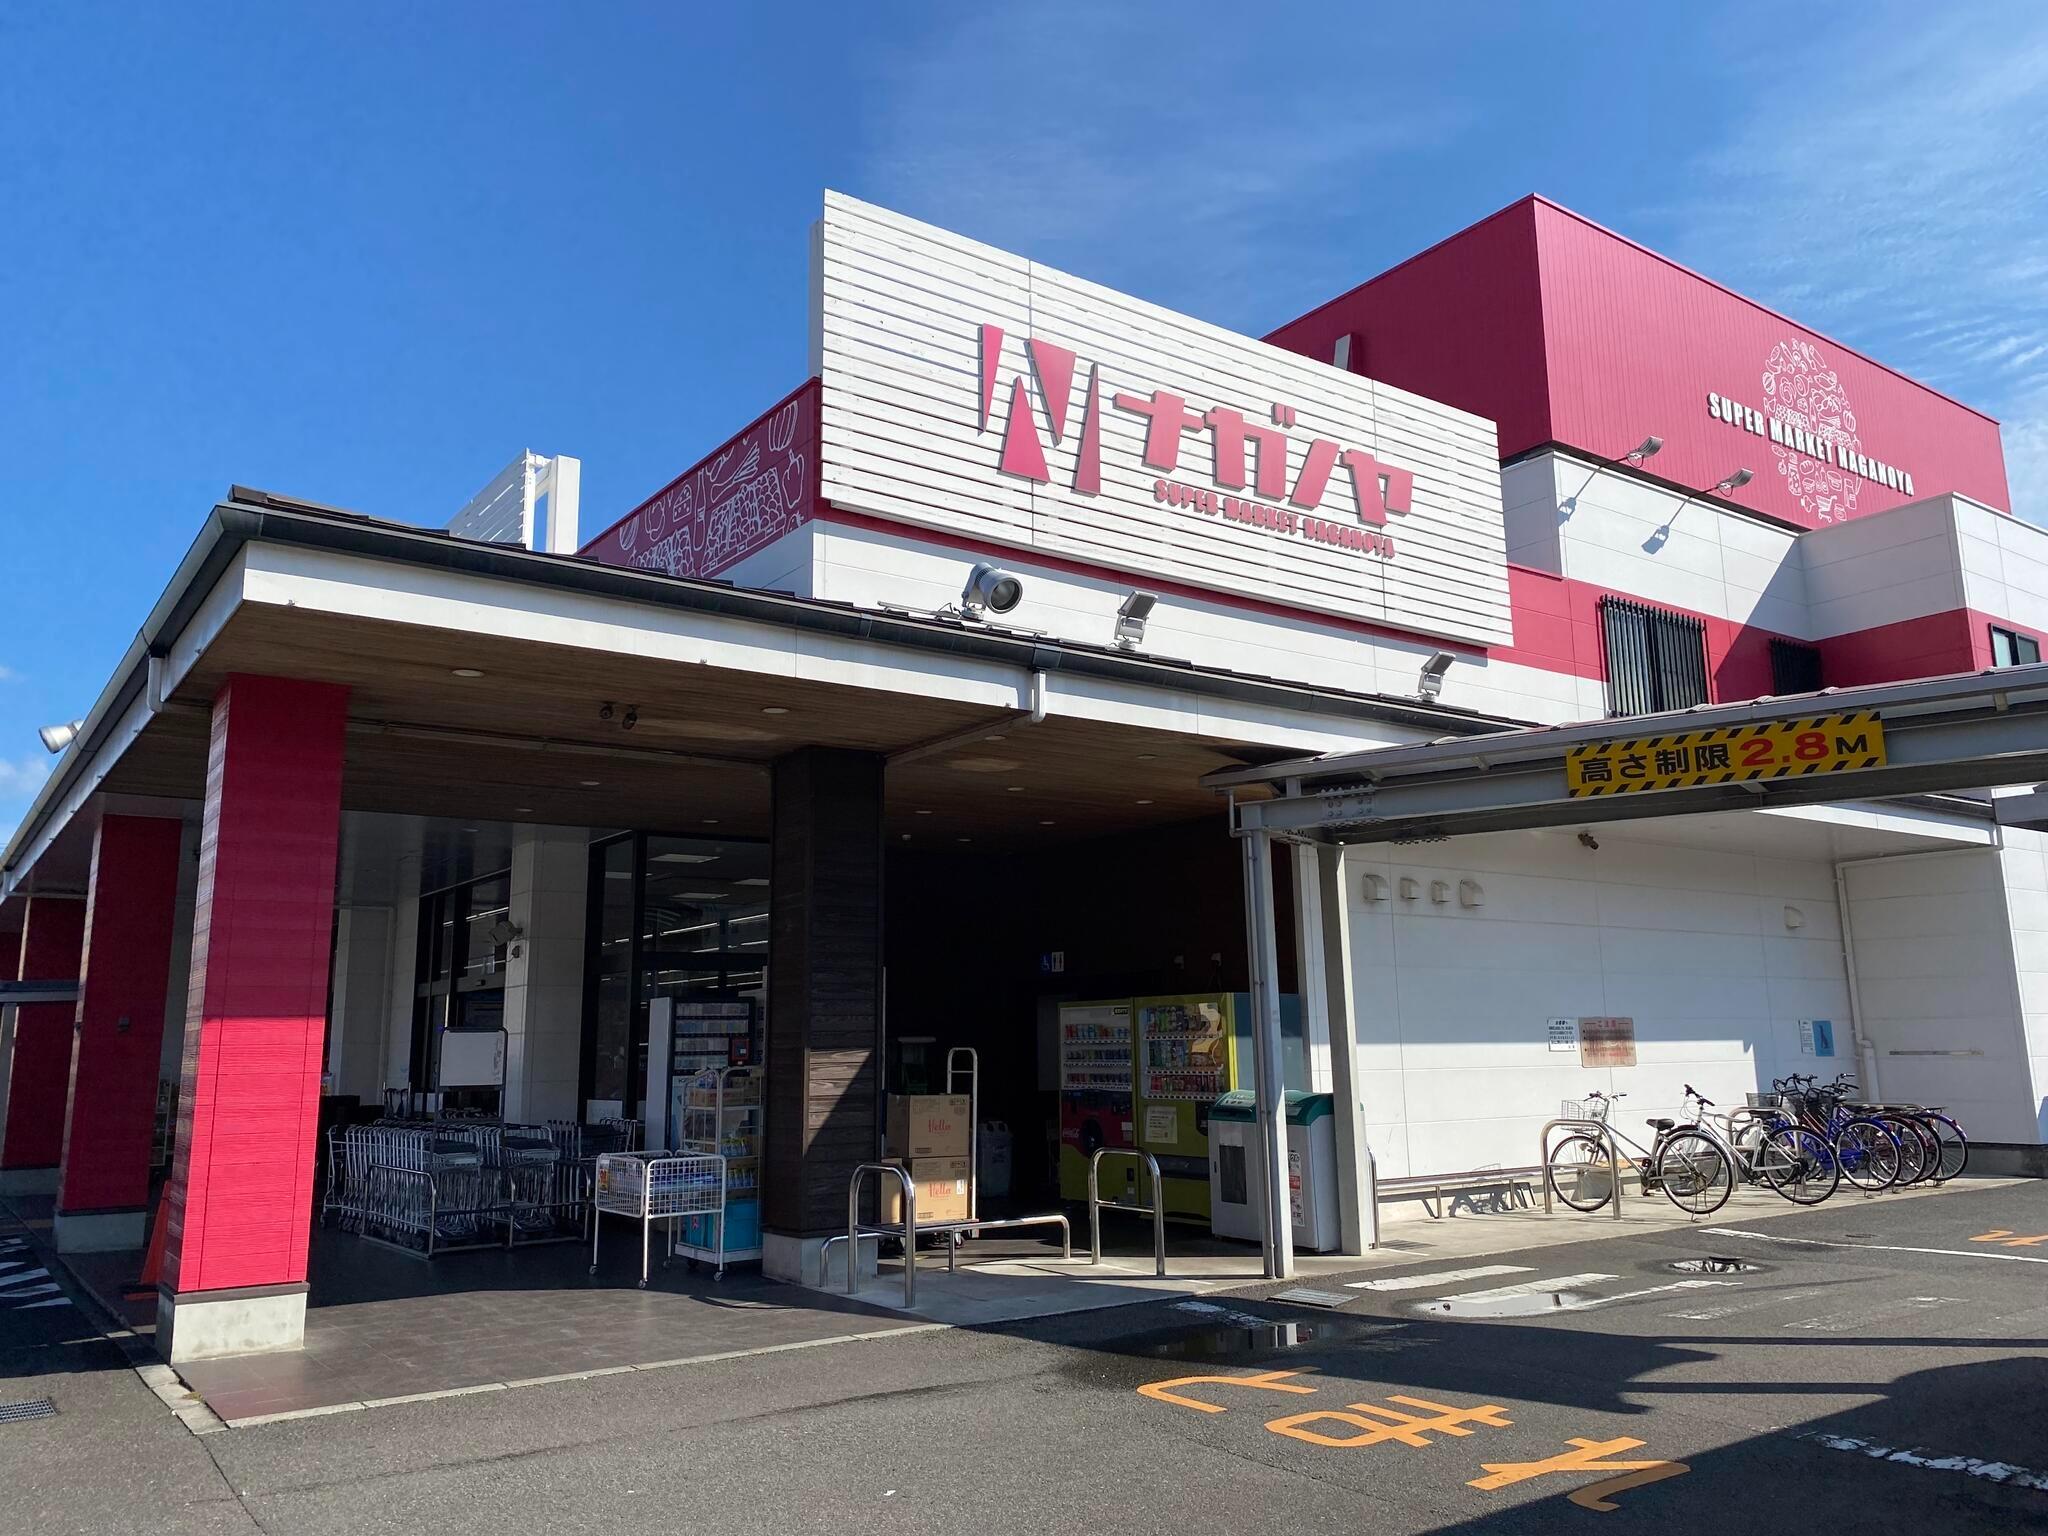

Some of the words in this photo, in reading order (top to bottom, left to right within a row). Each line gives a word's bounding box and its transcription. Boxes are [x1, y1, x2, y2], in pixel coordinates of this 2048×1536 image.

[1111, 389, 1414, 527] ナガノヤ
[1708, 392, 1765, 436] SUPER
[1769, 416, 1833, 463] MARKET
[1837, 445, 1915, 496] NAGANOYA
[1153, 479, 1219, 516] SUPER
[1223, 497, 1299, 535] MARKET
[1303, 517, 1396, 559] NAGANOYA
